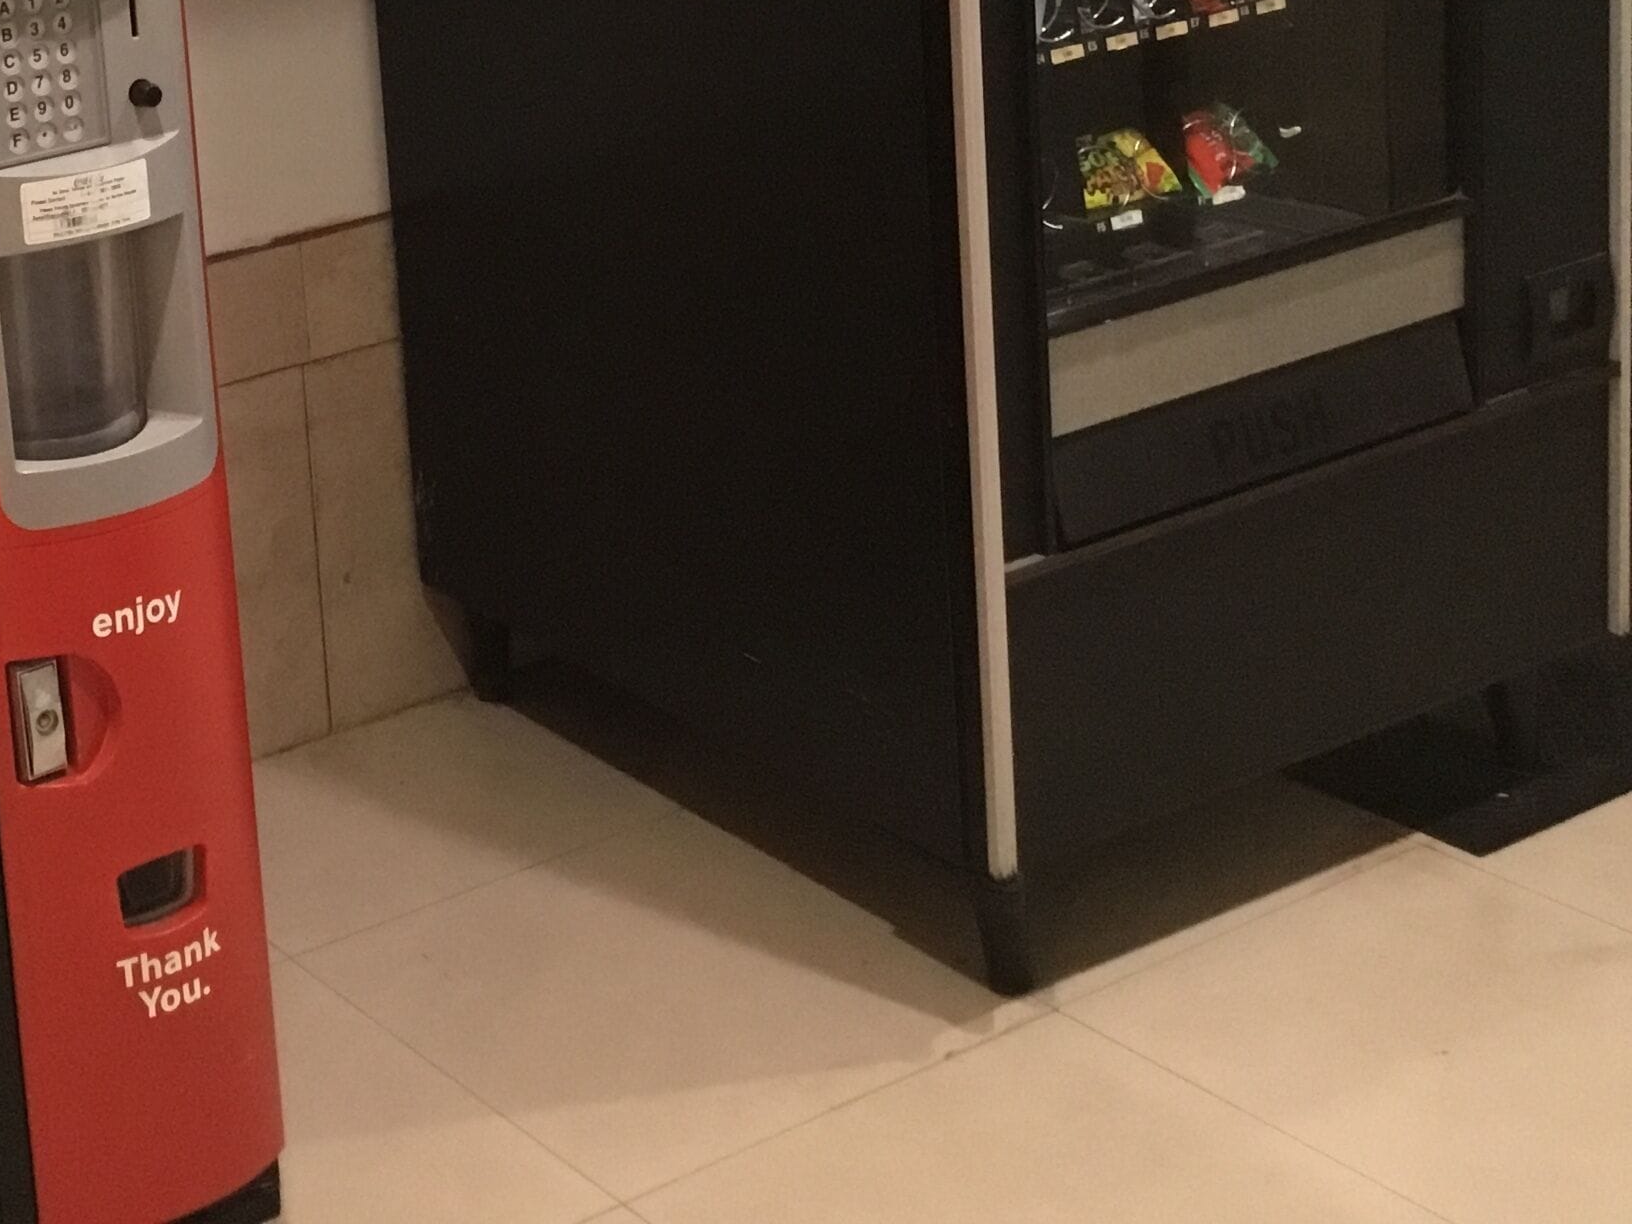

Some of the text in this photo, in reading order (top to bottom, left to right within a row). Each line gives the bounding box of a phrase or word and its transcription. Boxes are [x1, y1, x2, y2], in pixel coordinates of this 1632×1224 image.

[0, 1, 10, 16] A
[0, 16, 66, 43] B 3 4
[3, 42, 69, 69] C 5 6
[6, 69, 72, 95] D 7 8
[10, 107, 20, 122] E
[37, 101, 47, 115] 9
[12, 133, 23, 148] F
[91, 589, 183, 638] enjoy
[116, 927, 222, 988] Thank
[138, 976, 212, 1019] You.
